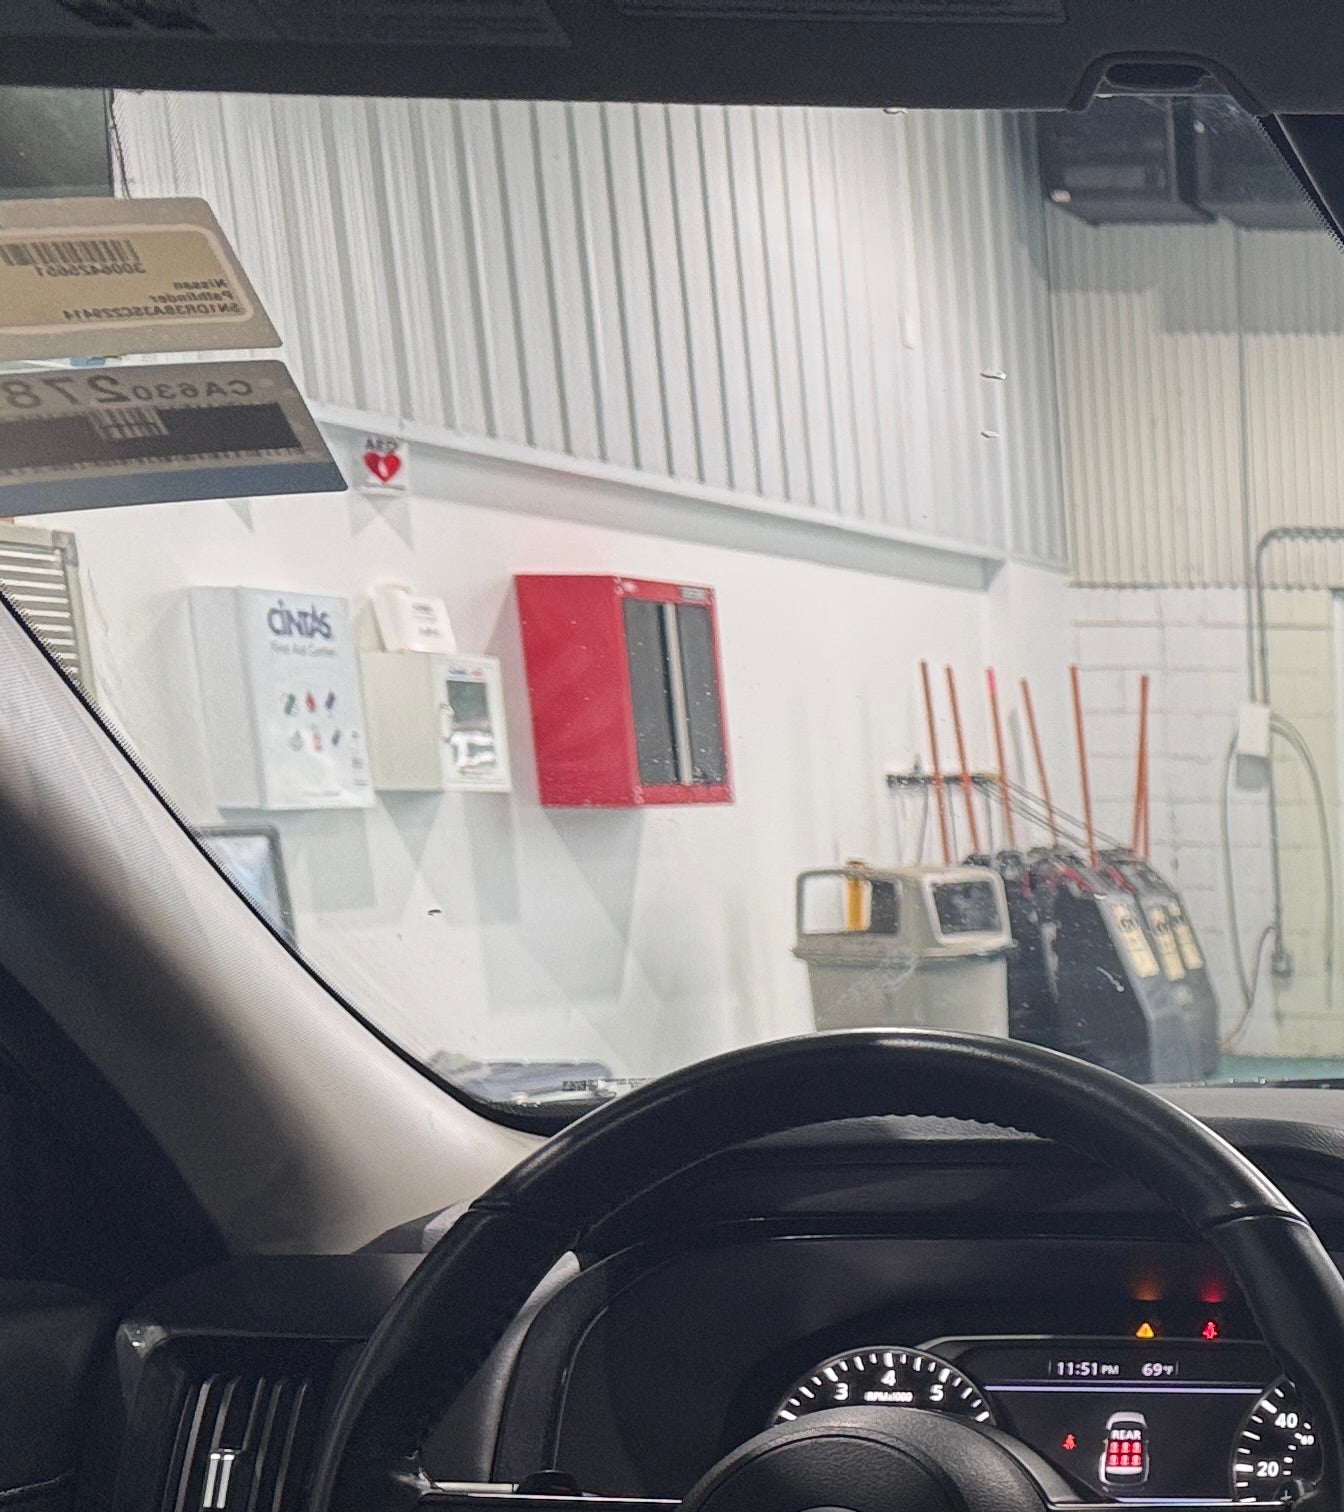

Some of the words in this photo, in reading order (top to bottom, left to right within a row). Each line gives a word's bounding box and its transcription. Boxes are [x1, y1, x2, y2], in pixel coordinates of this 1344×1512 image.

[1057, 1362, 1098, 1376] 11:51
[1101, 1364, 1119, 1375] PM
[881, 1369, 896, 1386] 4
[834, 1382, 848, 1400] 3
[929, 1384, 944, 1401] 5
[1274, 1413, 1299, 1428] 40
[1111, 1429, 1142, 1440] REAR
[1256, 1462, 1279, 1477] 20
